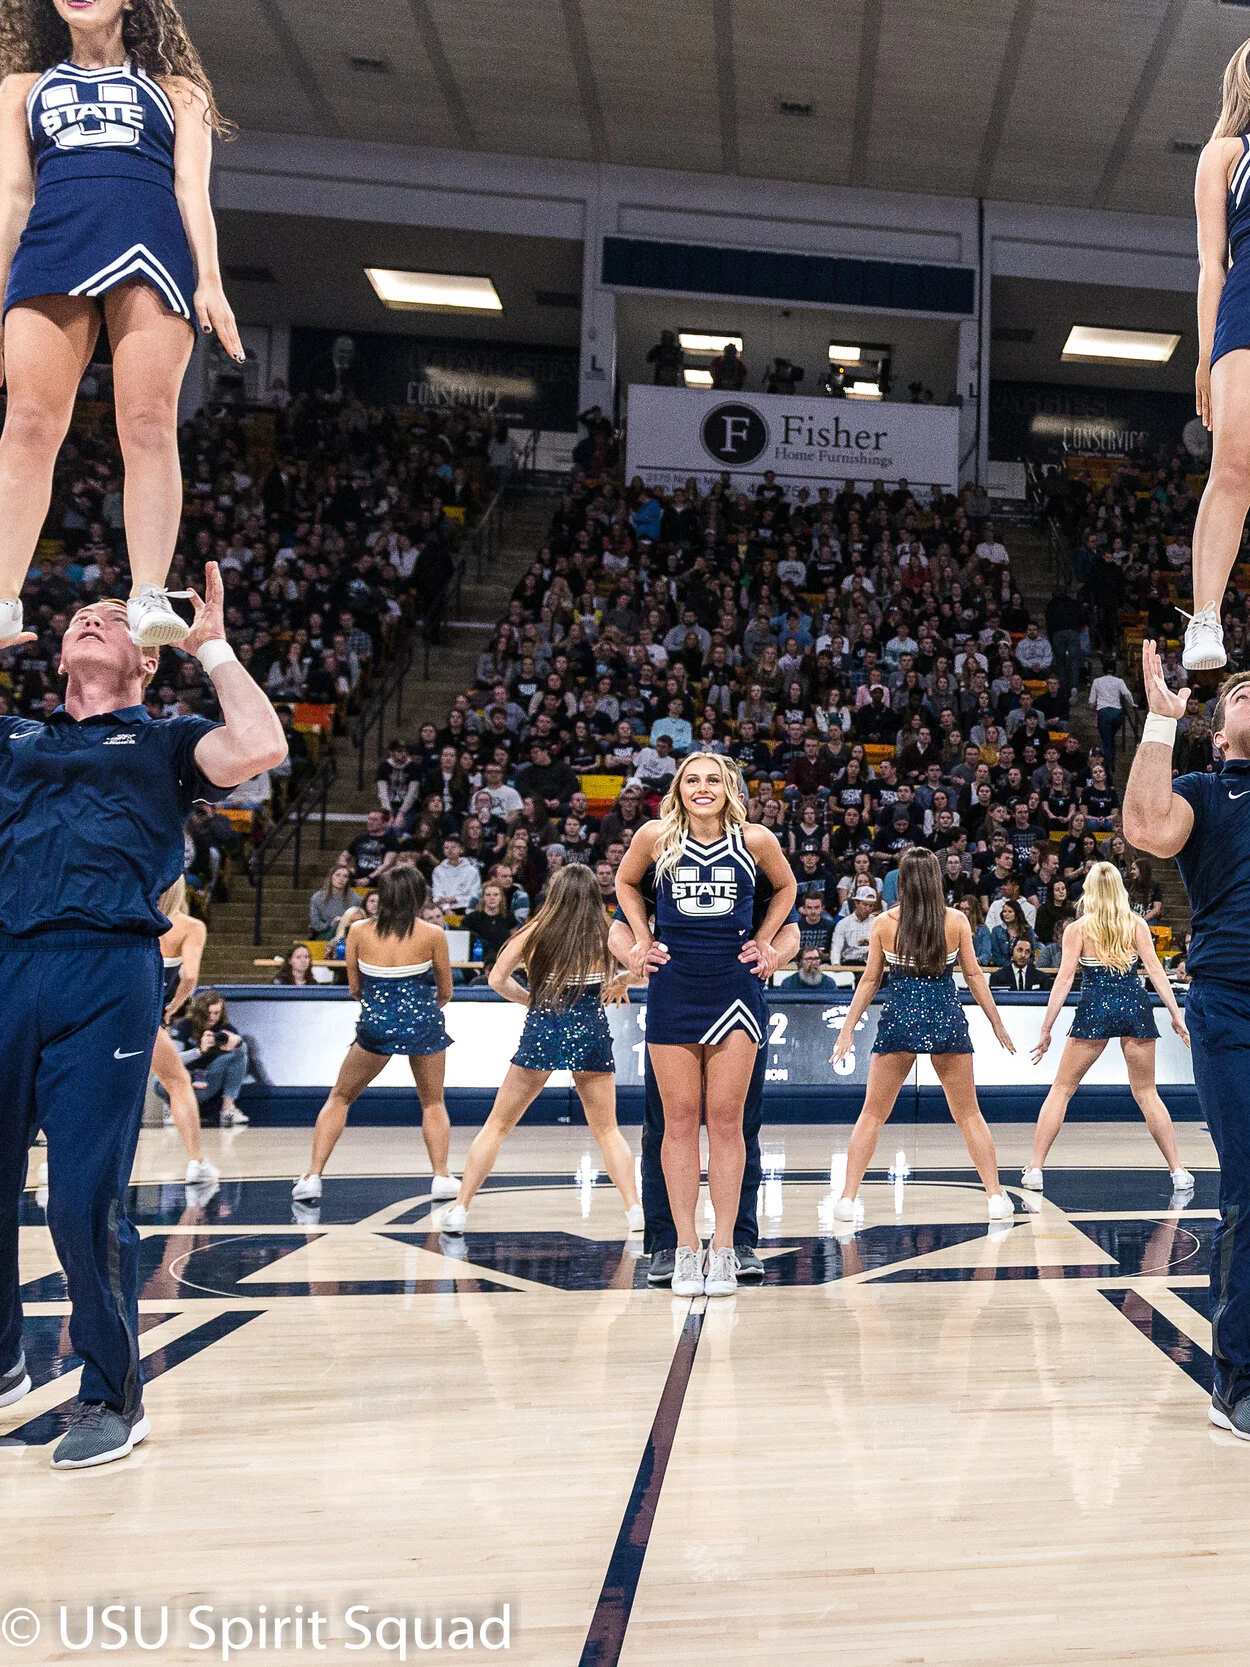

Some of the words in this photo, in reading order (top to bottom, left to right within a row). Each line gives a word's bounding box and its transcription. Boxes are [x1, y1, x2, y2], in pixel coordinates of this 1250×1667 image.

[40, 103, 144, 136] STATE
[719, 416, 749, 453] F
[780, 414, 889, 451] Fisher
[774, 447, 815, 462] Home
[818, 450, 894, 469] Furnishings
[671, 882, 738, 900] STATE
[769, 1012, 789, 1045] 2
